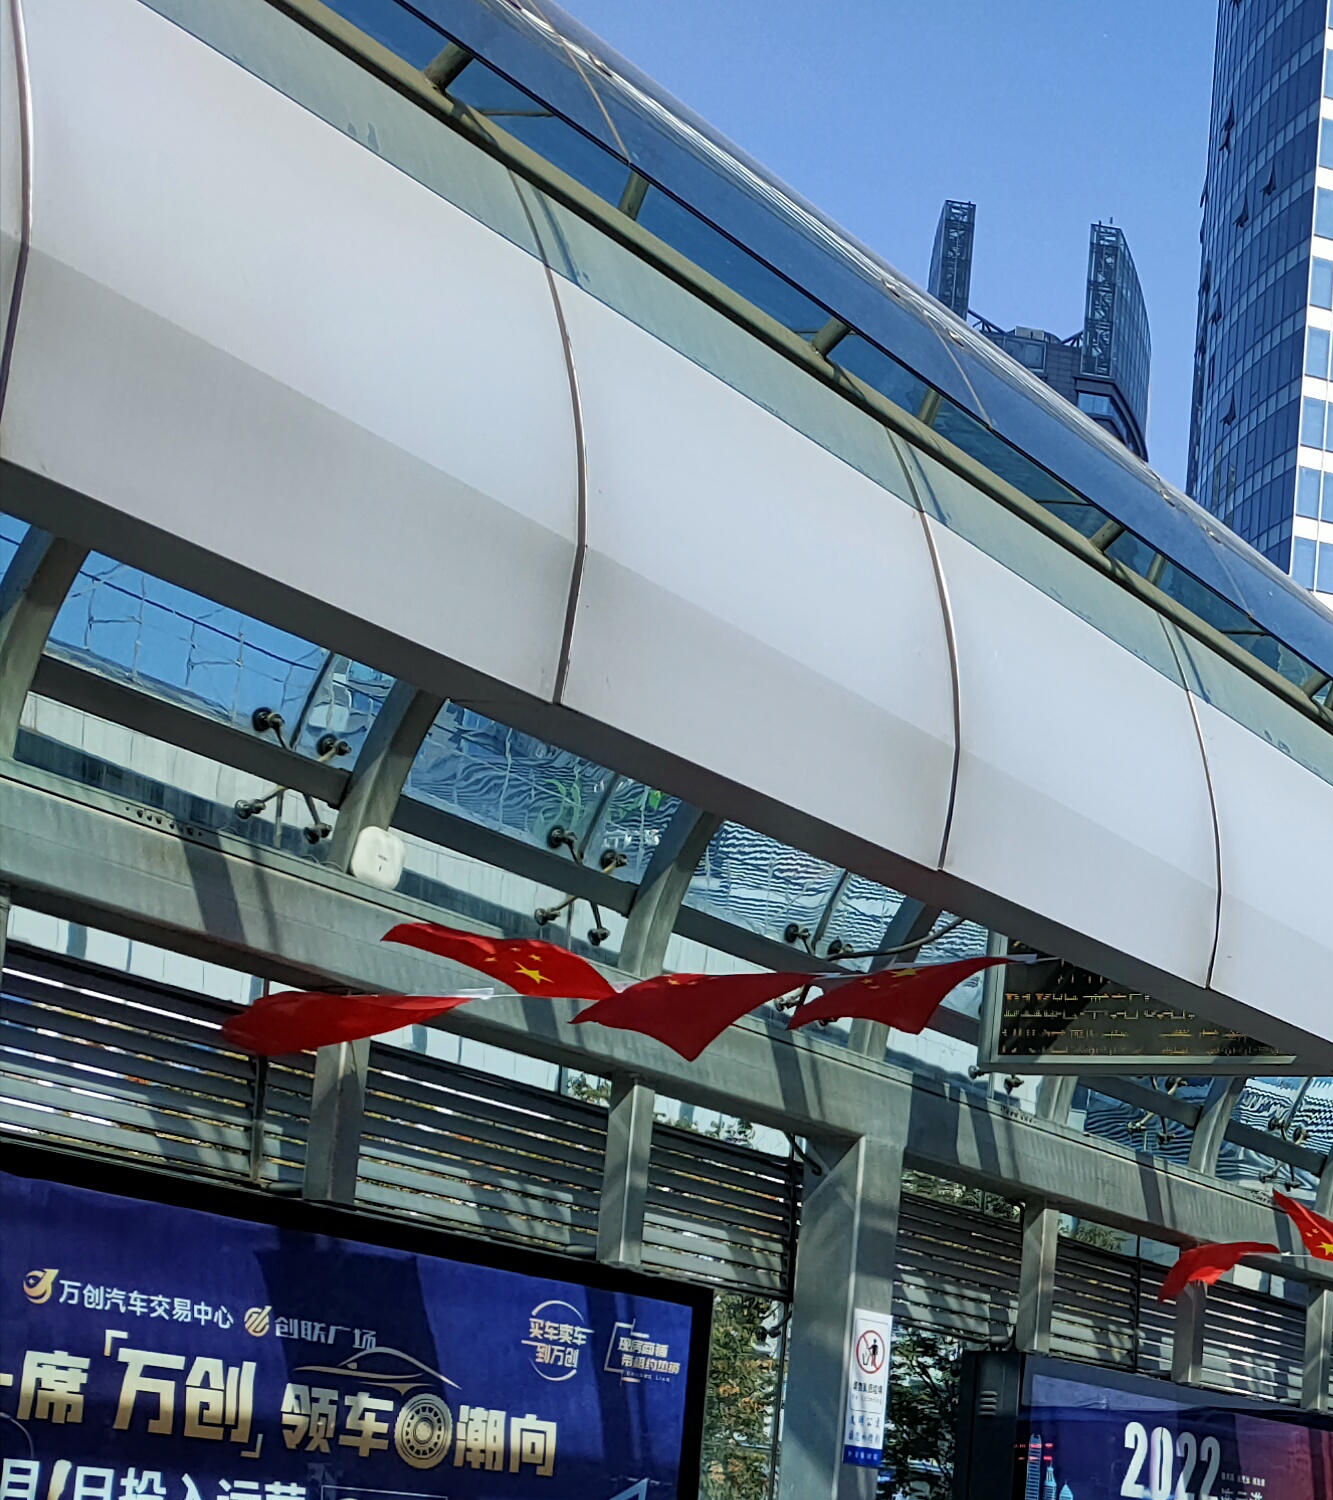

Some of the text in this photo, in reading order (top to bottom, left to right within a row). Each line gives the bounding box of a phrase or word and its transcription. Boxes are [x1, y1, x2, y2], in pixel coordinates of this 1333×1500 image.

[58, 1279, 234, 1330] 万创汽车交易中心
[274, 1315, 378, 1350] 创联广场
[529, 1317, 595, 1346] 买车卖车
[535, 1344, 580, 1369] 到万创
